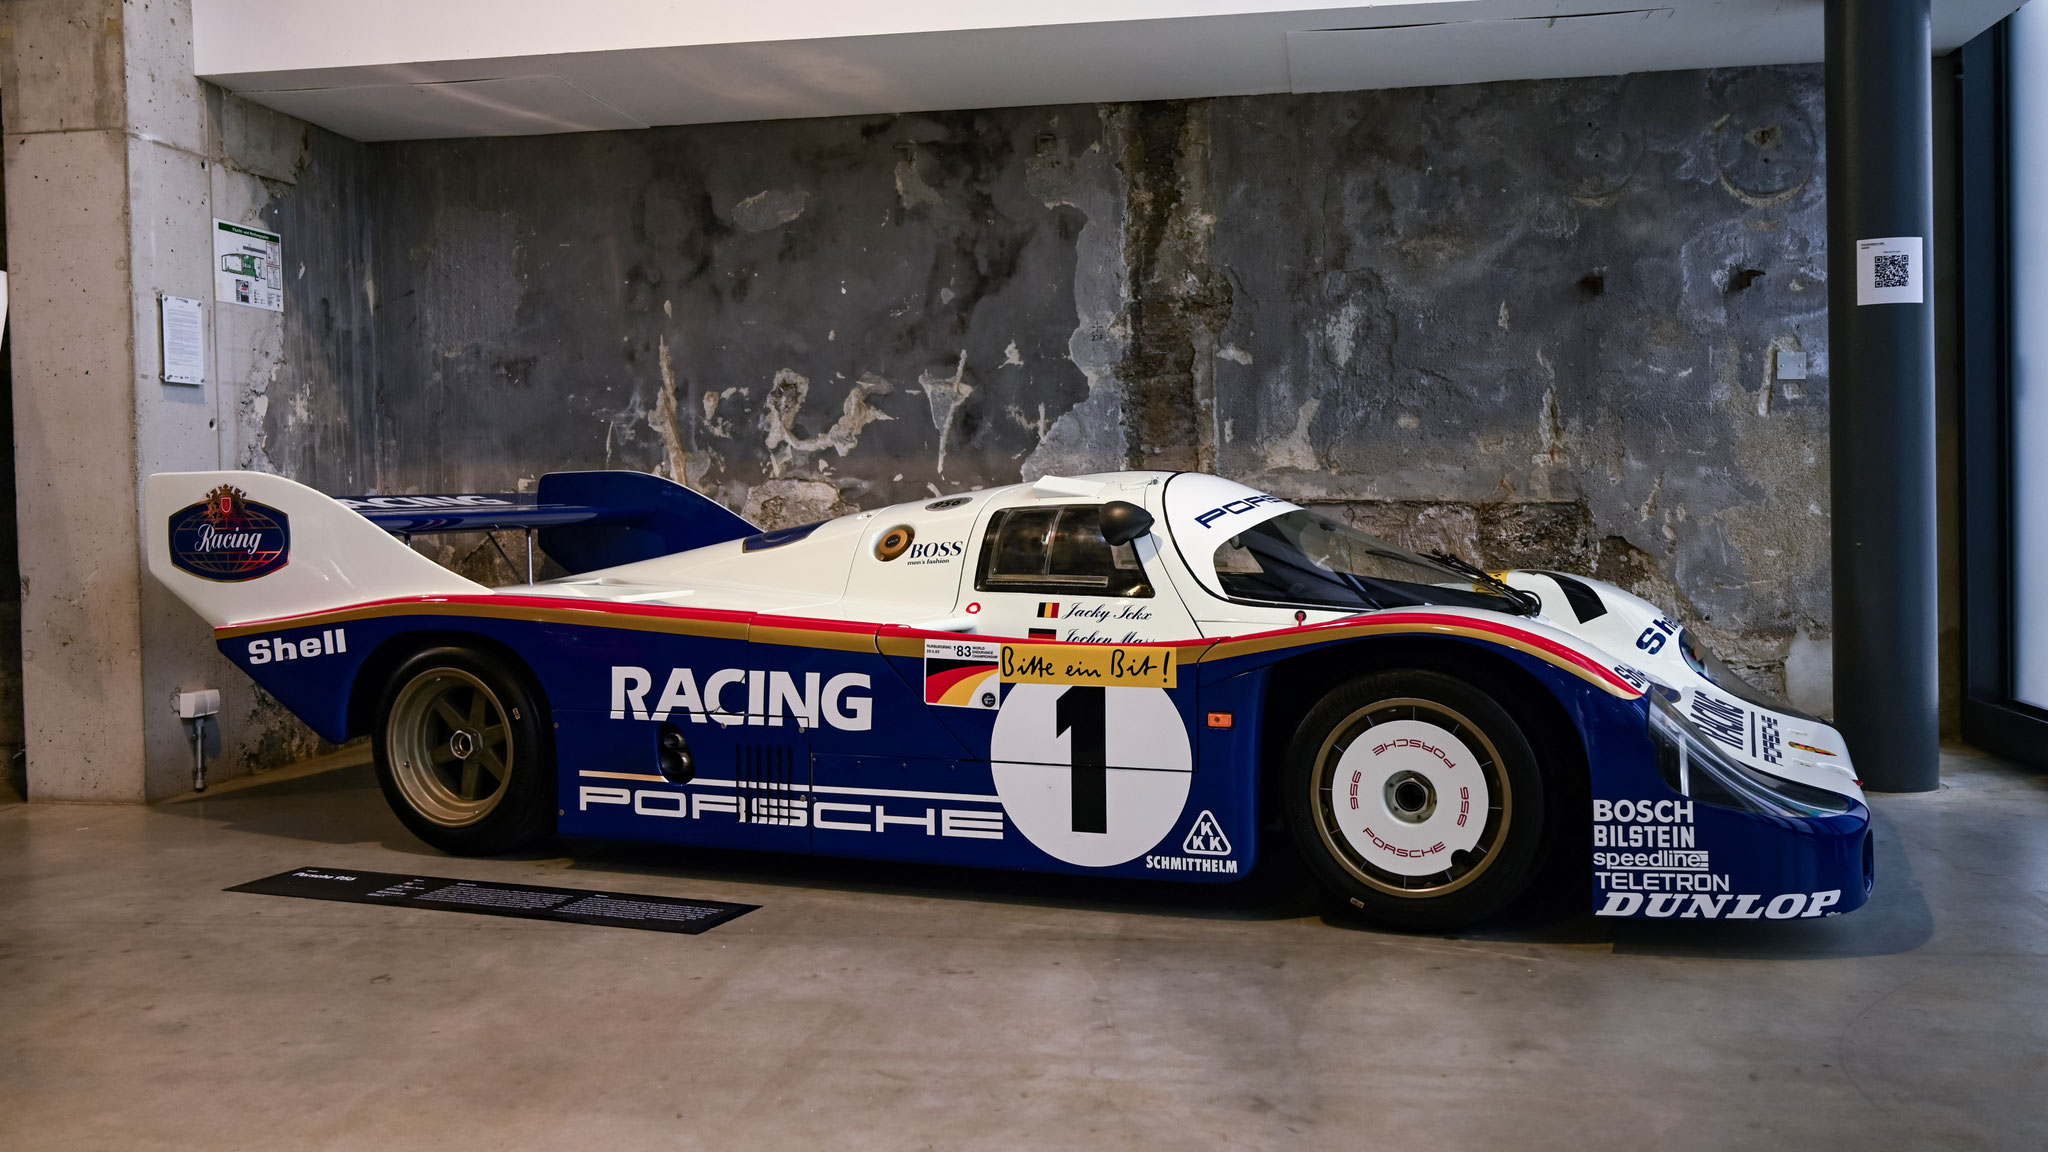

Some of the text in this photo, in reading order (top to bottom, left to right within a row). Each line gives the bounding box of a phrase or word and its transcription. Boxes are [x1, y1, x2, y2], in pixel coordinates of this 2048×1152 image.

[194, 523, 262, 556] Racing
[909, 540, 963, 559] BOSS
[1061, 602, 1153, 623] Jacky Ickx
[247, 628, 347, 665] Shell
[953, 645, 972, 658] '83
[1001, 645, 1055, 677] Bitte
[1065, 661, 1101, 678] ein
[610, 665, 873, 731] RACING
[1690, 690, 1744, 750] RACING
[1056, 685, 1107, 834] 1
[1372, 738, 1456, 769] PORSCHE
[1349, 770, 1362, 810] 956
[579, 785, 1004, 840] PORSCHE
[1457, 787, 1470, 827] 956
[1593, 799, 1694, 823] BOSCH
[1363, 827, 1446, 858] PORSCHE
[1593, 824, 1695, 848] BILSTEIN
[1145, 854, 1238, 873] SCHMITTHELM
[1593, 850, 1702, 870] speedline
[1594, 871, 1730, 892] TELETRON
[1595, 889, 1841, 920] DUNLOP
